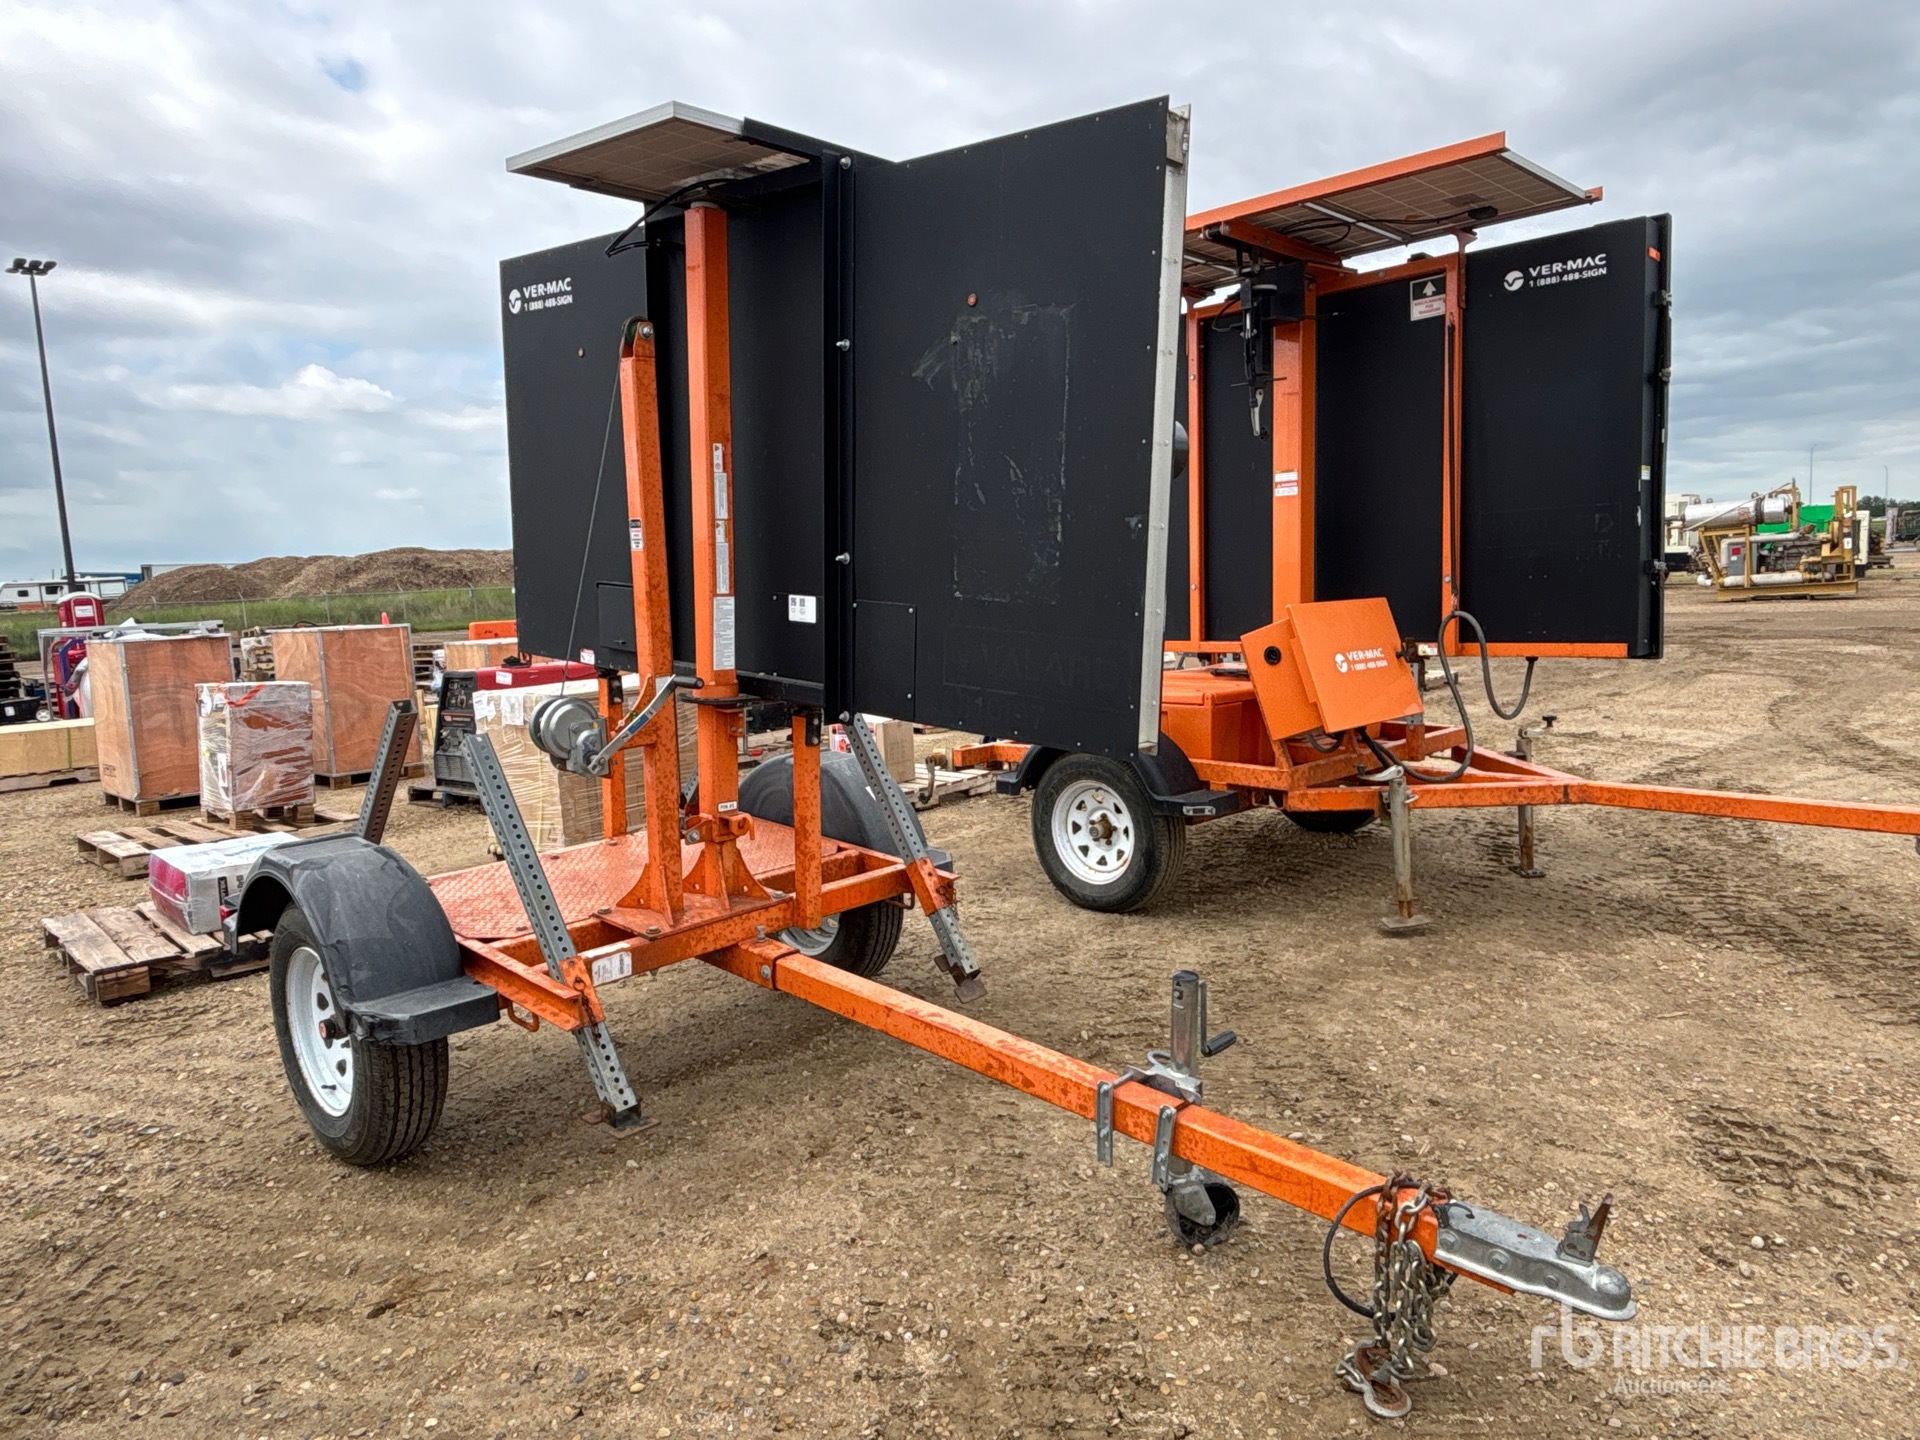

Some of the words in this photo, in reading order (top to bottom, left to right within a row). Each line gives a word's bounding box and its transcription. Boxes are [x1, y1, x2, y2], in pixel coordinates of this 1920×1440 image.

[1528, 253, 1607, 277] VER-MAC
[522, 277, 572, 298] VER-MAC
[1529, 280, 1534, 288] 1
[1536, 275, 1560, 287] (888)
[1562, 267, 1607, 281] 488-SIGN
[523, 302, 528, 312] 1
[1346, 648, 1384, 661] VER-MAC
